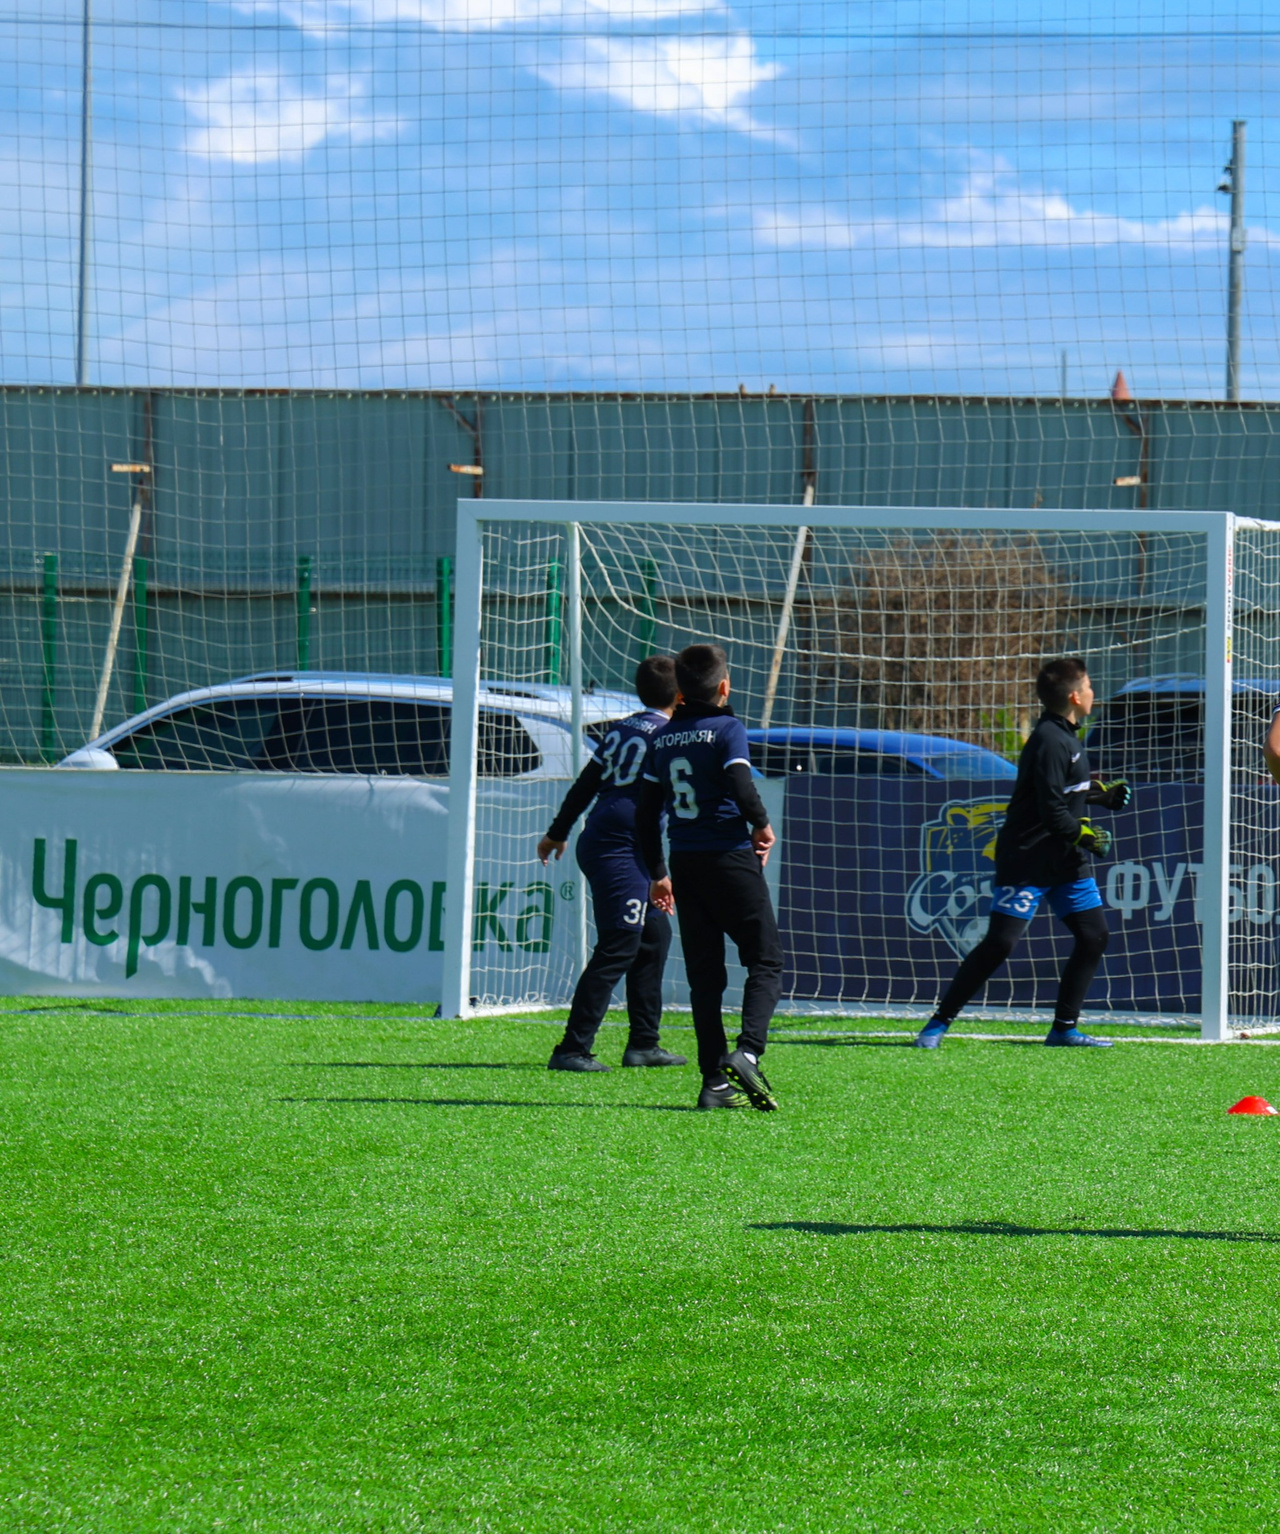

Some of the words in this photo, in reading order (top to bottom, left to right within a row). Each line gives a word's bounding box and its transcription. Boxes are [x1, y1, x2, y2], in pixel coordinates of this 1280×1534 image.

[600, 730, 647, 787] 30
[669, 757, 700, 820] 6
[997, 885, 1034, 913] 23
